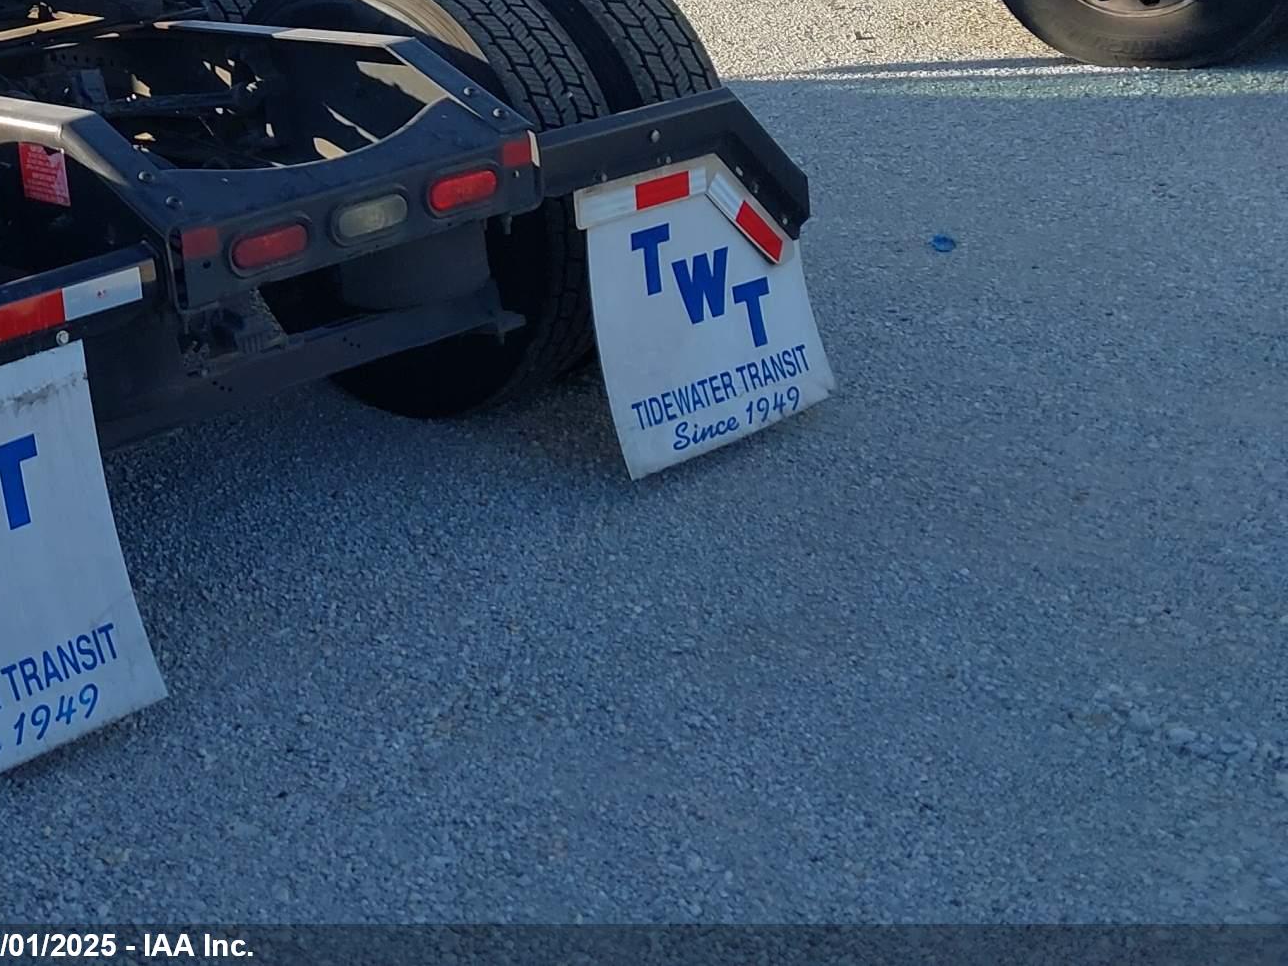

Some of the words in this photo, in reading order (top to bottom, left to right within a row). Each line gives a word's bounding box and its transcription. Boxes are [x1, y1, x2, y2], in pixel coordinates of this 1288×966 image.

[631, 370, 737, 431] TIDEWATER
[735, 344, 810, 395] TRANSIT
[673, 417, 739, 450] Since
[745, 385, 800, 426] 1949
[0, 622, 118, 702] TRANSIT
[14, 683, 100, 746] 1949
